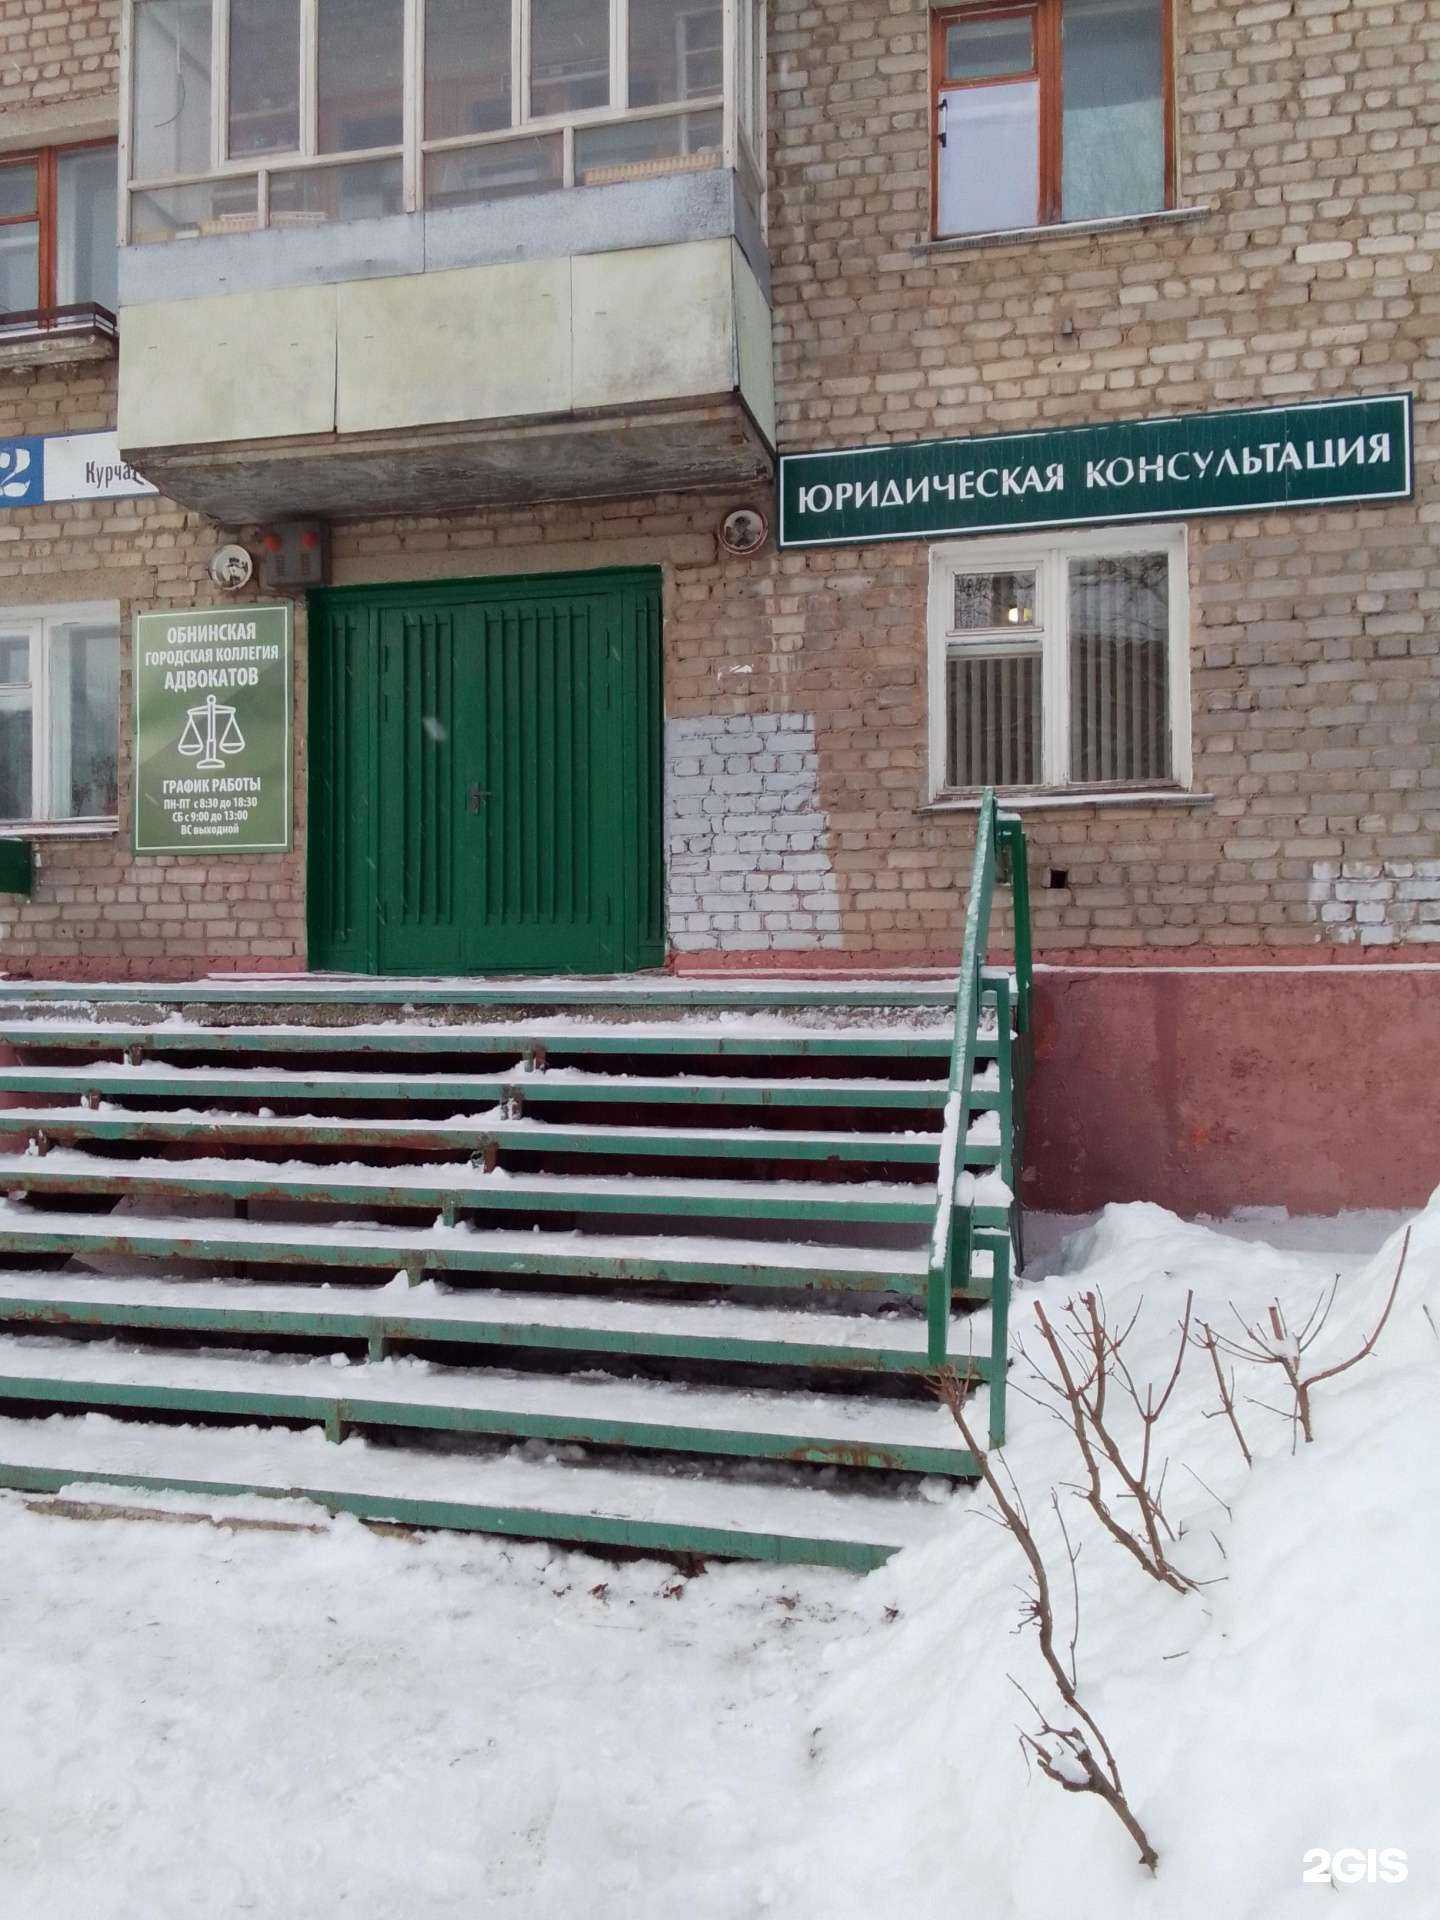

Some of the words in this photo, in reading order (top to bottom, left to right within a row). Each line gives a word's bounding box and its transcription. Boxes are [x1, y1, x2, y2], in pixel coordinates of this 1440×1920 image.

[798, 463, 1064, 514] ЮРИДИЧЕСКАЯ
[1086, 432, 1391, 488] КОНСУЛЬТАЦИЯ
[167, 622, 256, 644] ОБНИНСКАЯ
[145, 649, 213, 667] ГОРОДСКАЯ
[216, 645, 278, 662] КОЛЛЕГИЯ
[164, 667, 259, 693] АДВОКАТОВ
[162, 779, 210, 794] ГРАФИК
[212, 777, 261, 793] РАБОТЫ
[164, 798, 191, 810] ПН-ПТ
[194, 801, 199, 809] с
[199, 798, 218, 809] 8:30
[219, 800, 231, 810] до
[233, 797, 257, 808] 18:30
[172, 811, 183, 822] СБ
[184, 814, 190, 822] с
[190, 811, 209, 822] 9:00
[210, 813, 222, 823] до
[224, 810, 248, 821] 13:00
[181, 825, 192, 835] ВС
[193, 823, 239, 835] выходной
